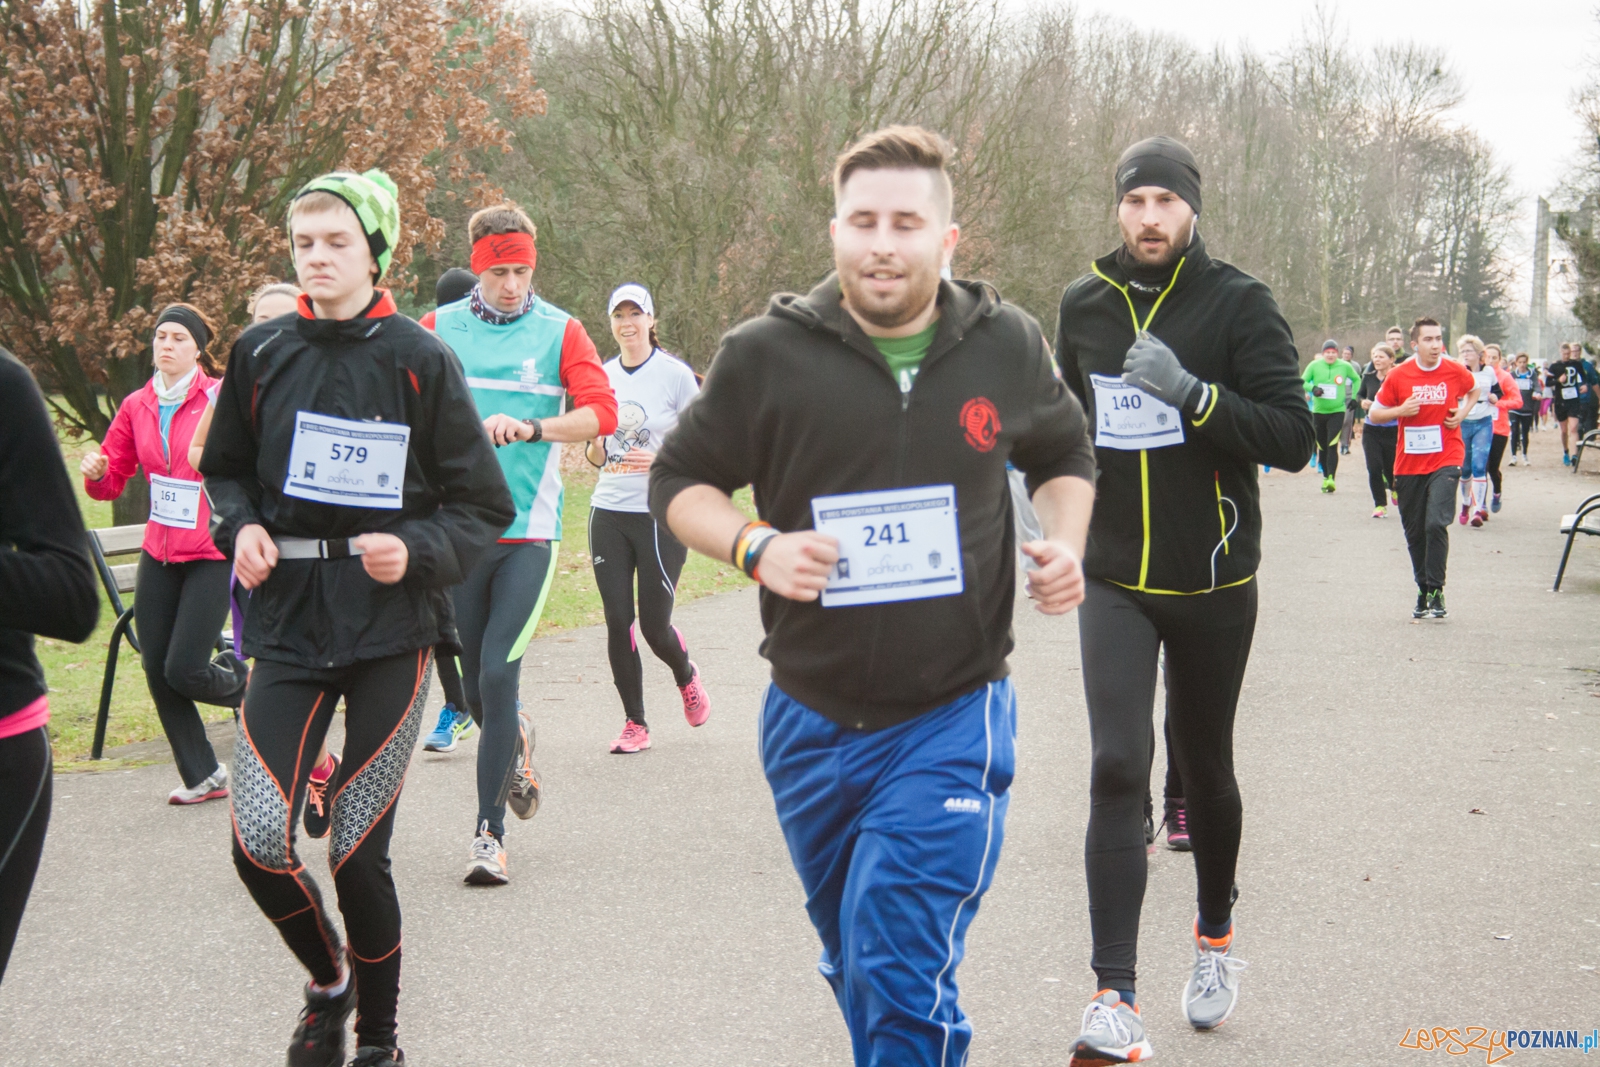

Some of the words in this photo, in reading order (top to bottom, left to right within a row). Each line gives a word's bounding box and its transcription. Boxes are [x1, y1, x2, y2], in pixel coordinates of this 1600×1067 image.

[1111, 394, 1142, 411] 140
[330, 442, 368, 464] 579
[327, 472, 364, 486] parkrun
[161, 490, 176, 502] 161
[841, 506, 882, 517] POWSTANIA
[884, 499, 946, 512] WIELKOPOLSKIEGO
[862, 522, 910, 547] 241
[867, 560, 913, 578] parkrun
